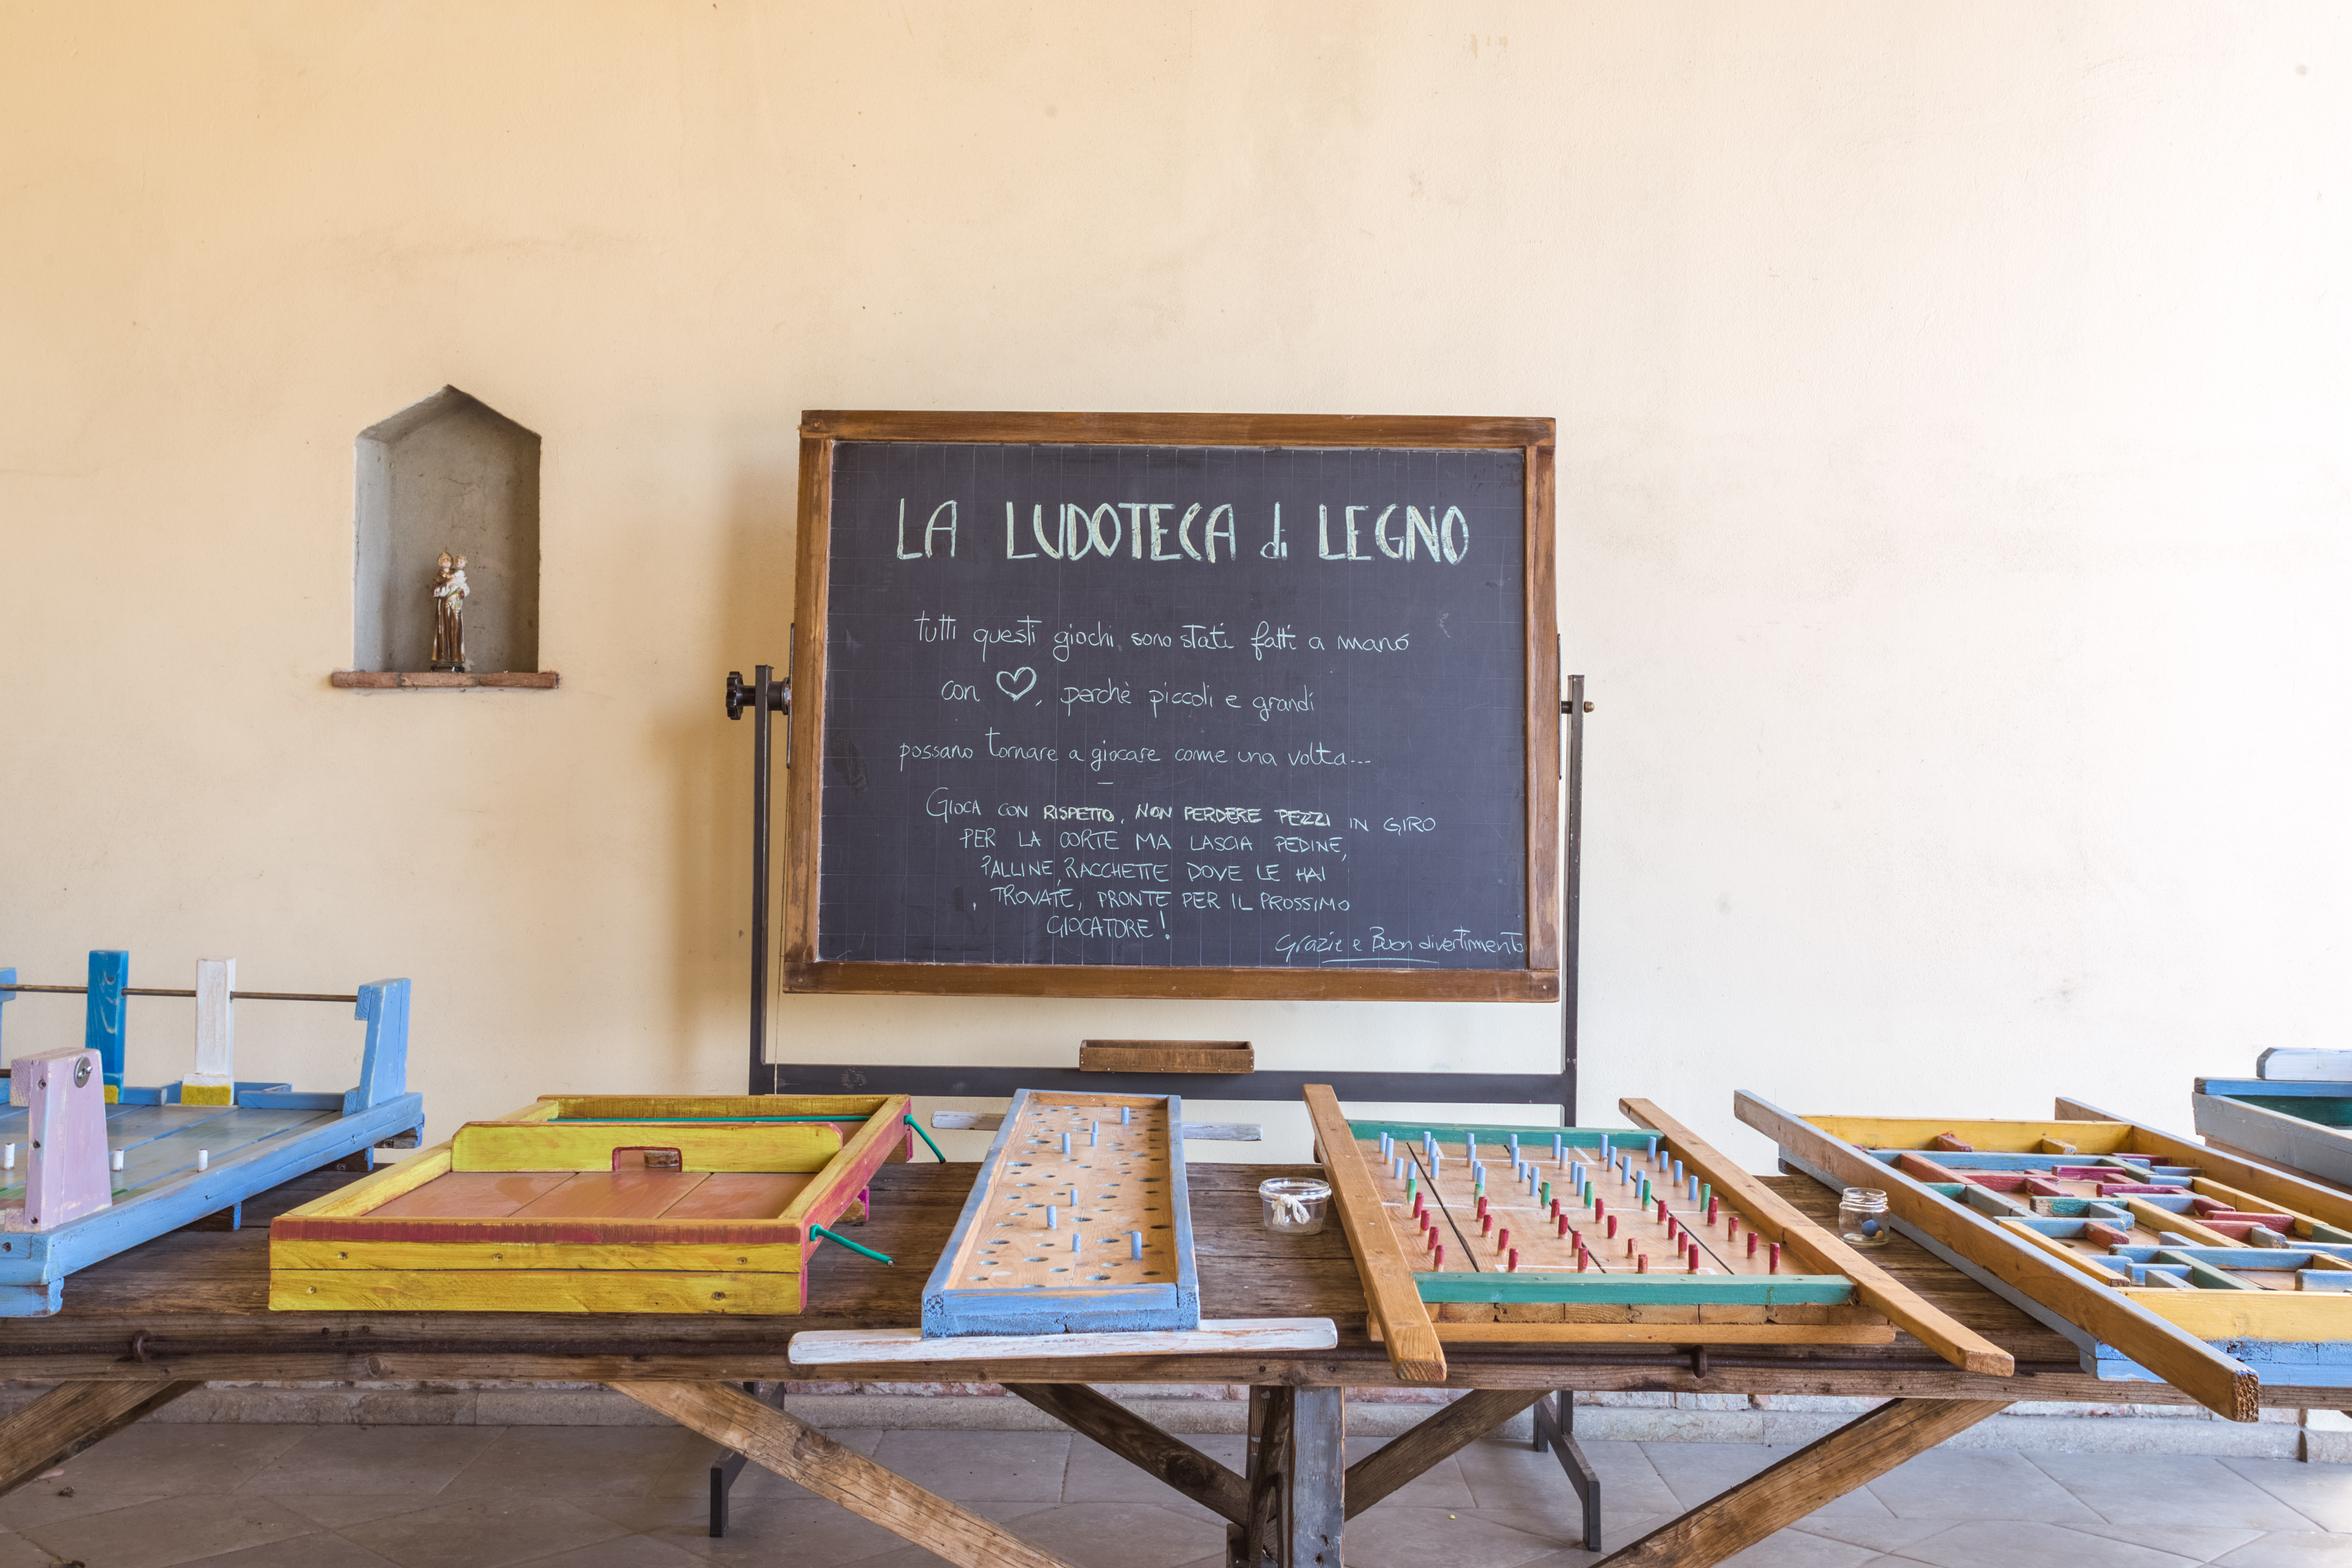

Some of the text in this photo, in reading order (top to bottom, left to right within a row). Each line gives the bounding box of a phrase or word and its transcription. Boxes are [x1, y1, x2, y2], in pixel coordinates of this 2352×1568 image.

[897, 497, 1470, 565] LA LUDOTECA di LEGNO
[914, 610, 957, 642] tutti
[973, 615, 1042, 662] questi
[1053, 621, 1114, 662] giochi
[1130, 632, 1172, 647] sono
[1180, 622, 1234, 649] stati
[1250, 621, 1297, 661] fatti
[1308, 637, 1325, 650] a
[941, 680, 980, 702] con
[1148, 681, 1213, 718] piccoli
[1225, 695, 1242, 708] e
[1252, 684, 1314, 721] grandi
[900, 743, 973, 772] possano
[985, 726, 1059, 761] tornare
[1069, 750, 1085, 761] a
[1091, 740, 1161, 772] giocare
[1175, 748, 1228, 763] come
[1237, 751, 1277, 766] una
[998, 803, 1028, 818] CON
[1135, 802, 1173, 820] NON
[1184, 806, 1262, 824] PERDERE
[1274, 808, 1331, 827] PEZZI
[1350, 818, 1370, 832] IN
[1383, 816, 1436, 836] GIRO
[959, 827, 996, 848] PER
[1018, 830, 1041, 847] LA
[1060, 829, 1120, 850] CORTE
[1136, 833, 1172, 851] MA
[1190, 835, 1253, 851] LASCIA
[1064, 857, 1169, 882] RACCHETTE
[1186, 862, 1243, 882] DOVE
[1256, 864, 1280, 882] LE
[1295, 866, 1326, 883] HAI
[1097, 890, 1172, 908] PRONTE
[1182, 891, 1221, 910] PER
[1231, 893, 1253, 911] IL
[1260, 891, 1351, 912] PROSSIMO
[1275, 925, 1524, 963] Grazie e Buon divertimento
